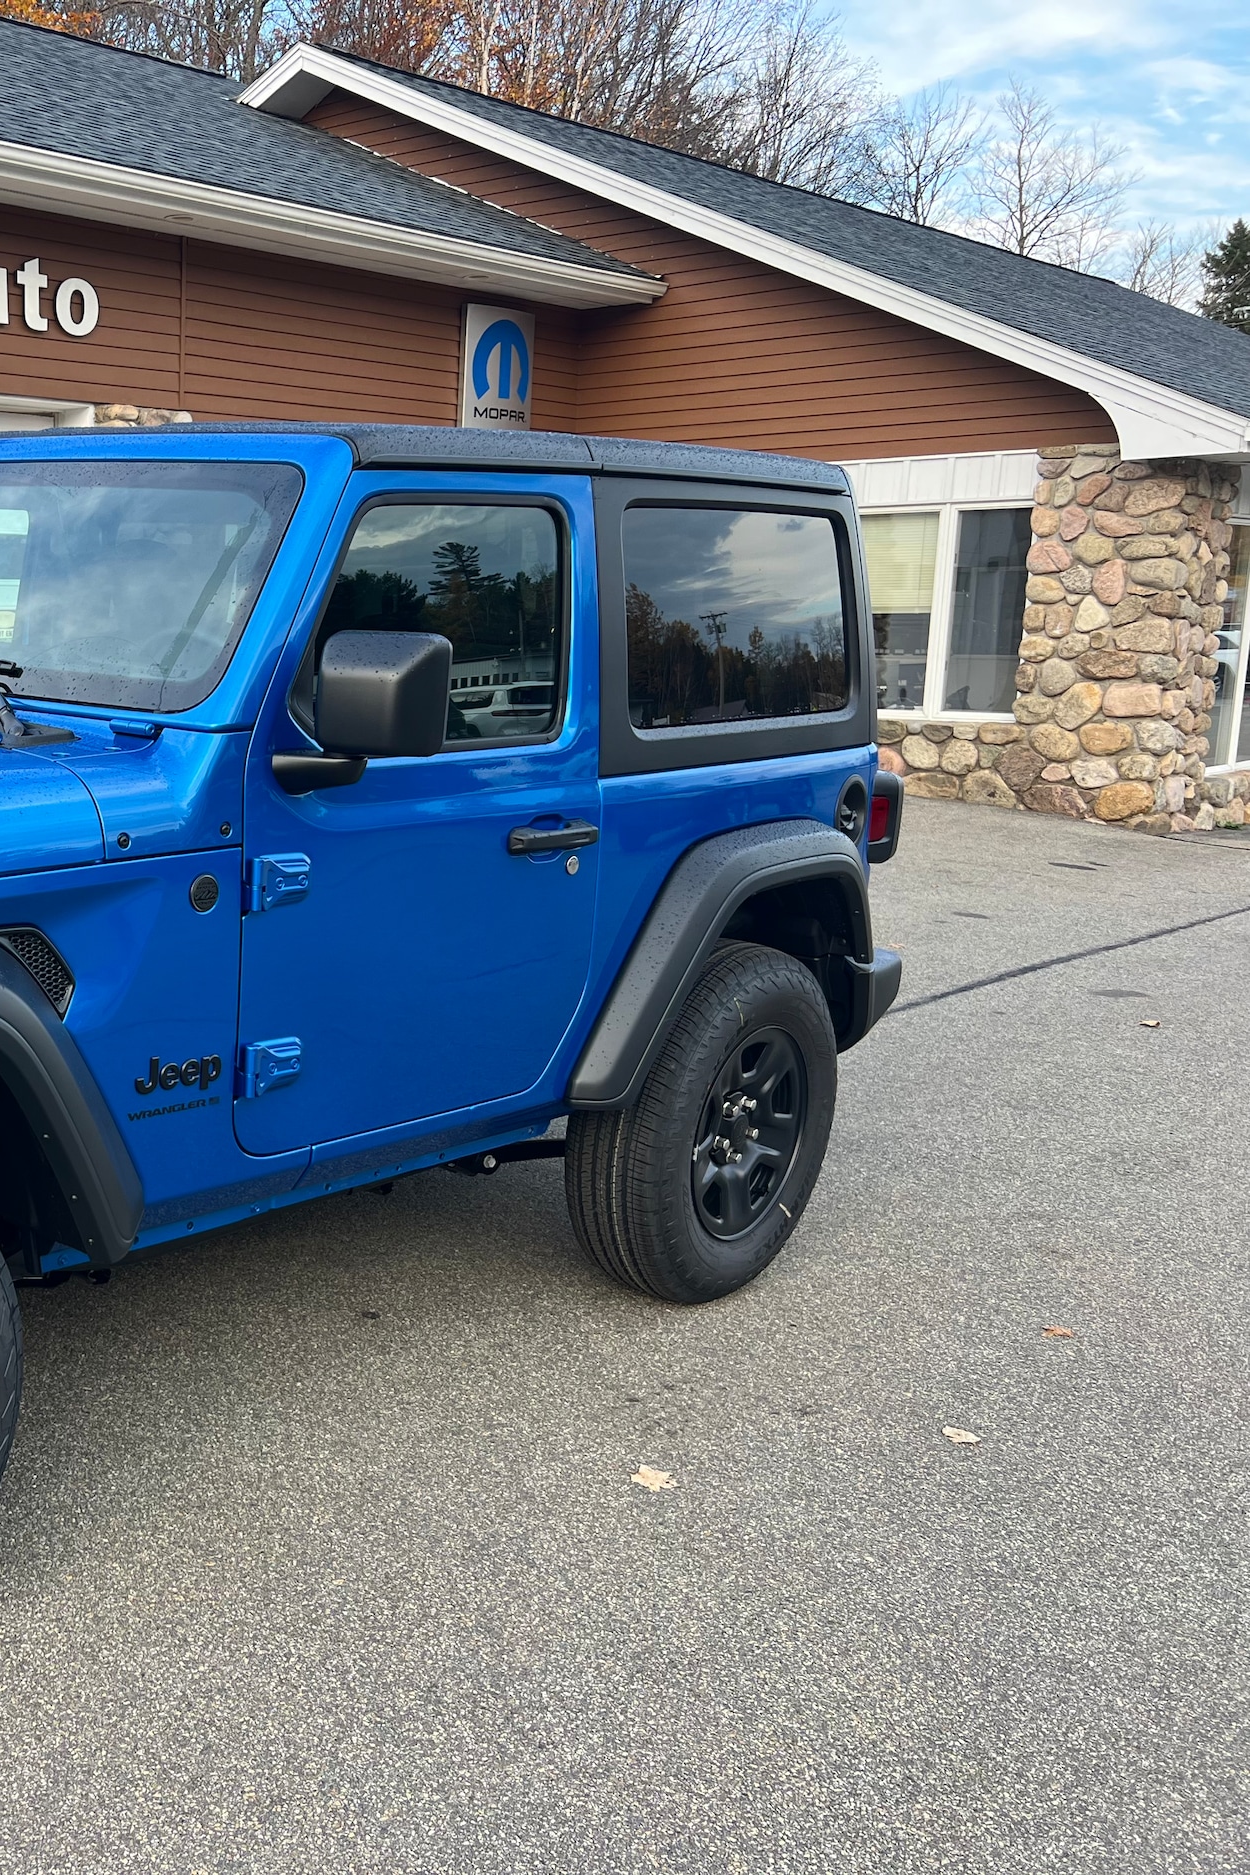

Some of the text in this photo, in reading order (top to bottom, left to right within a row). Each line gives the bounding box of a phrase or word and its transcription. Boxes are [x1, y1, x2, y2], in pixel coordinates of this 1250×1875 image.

[473, 406, 526, 423] MOPAR
[134, 1053, 222, 1096] Jeep
[127, 1098, 207, 1122] WRANGLER
